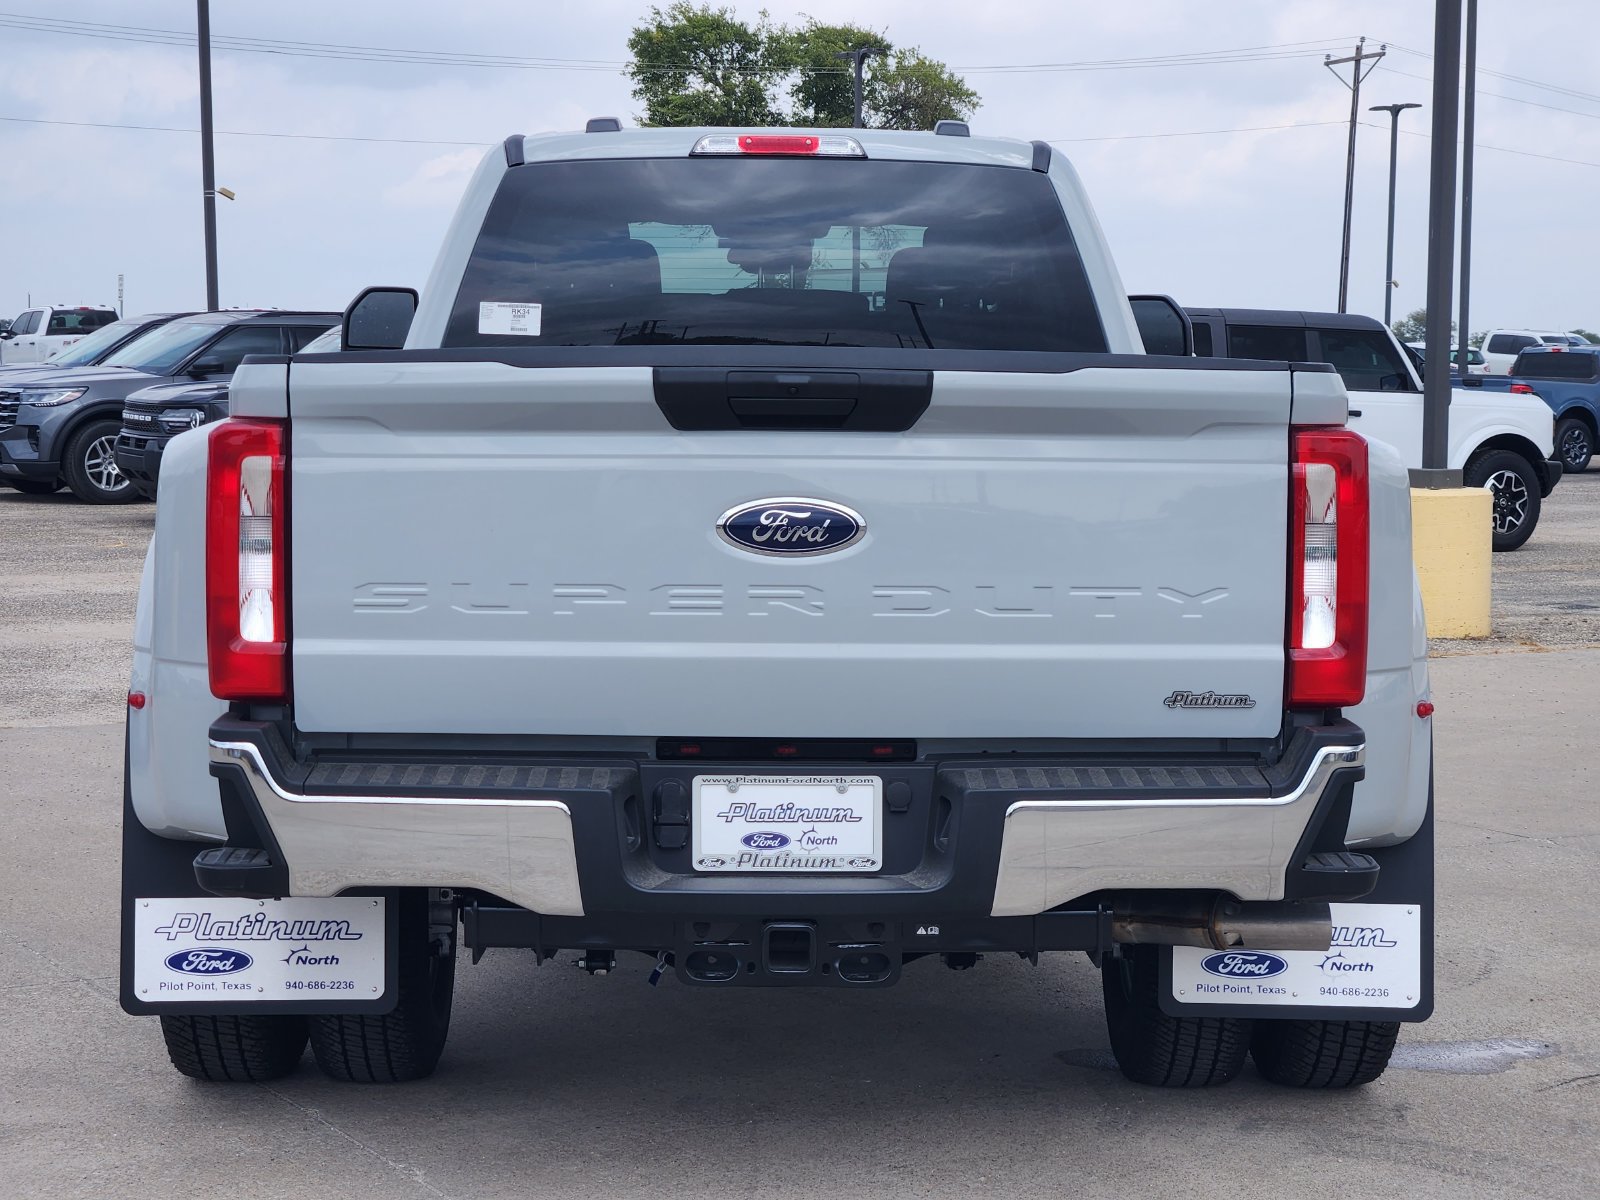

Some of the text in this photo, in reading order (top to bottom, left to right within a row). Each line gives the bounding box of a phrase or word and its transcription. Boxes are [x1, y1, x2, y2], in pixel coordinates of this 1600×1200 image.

[752, 509, 830, 542] Ford
[353, 581, 1229, 619] SUPER DUTY
[1163, 690, 1257, 709] Platinum
[701, 776, 875, 785] www.PlatinumFordNorth.com
[716, 802, 863, 823] Platinum
[750, 834, 781, 848] Ford
[806, 835, 838, 846] North
[702, 858, 722, 867] Ford
[733, 852, 843, 869] Platinum
[852, 858, 873, 867] Ford
[154, 911, 363, 941] Platinum
[182, 949, 236, 972] Ford
[295, 954, 340, 966] North
[1217, 954, 1270, 975] Ford
[1329, 961, 1374, 972] North
[159, 981, 252, 992] Pilot Point, Texas
[285, 980, 355, 990] 940-686-2236
[1196, 983, 1287, 995] Pilot Point, Texas
[1319, 986, 1390, 997] 940-686-2236
